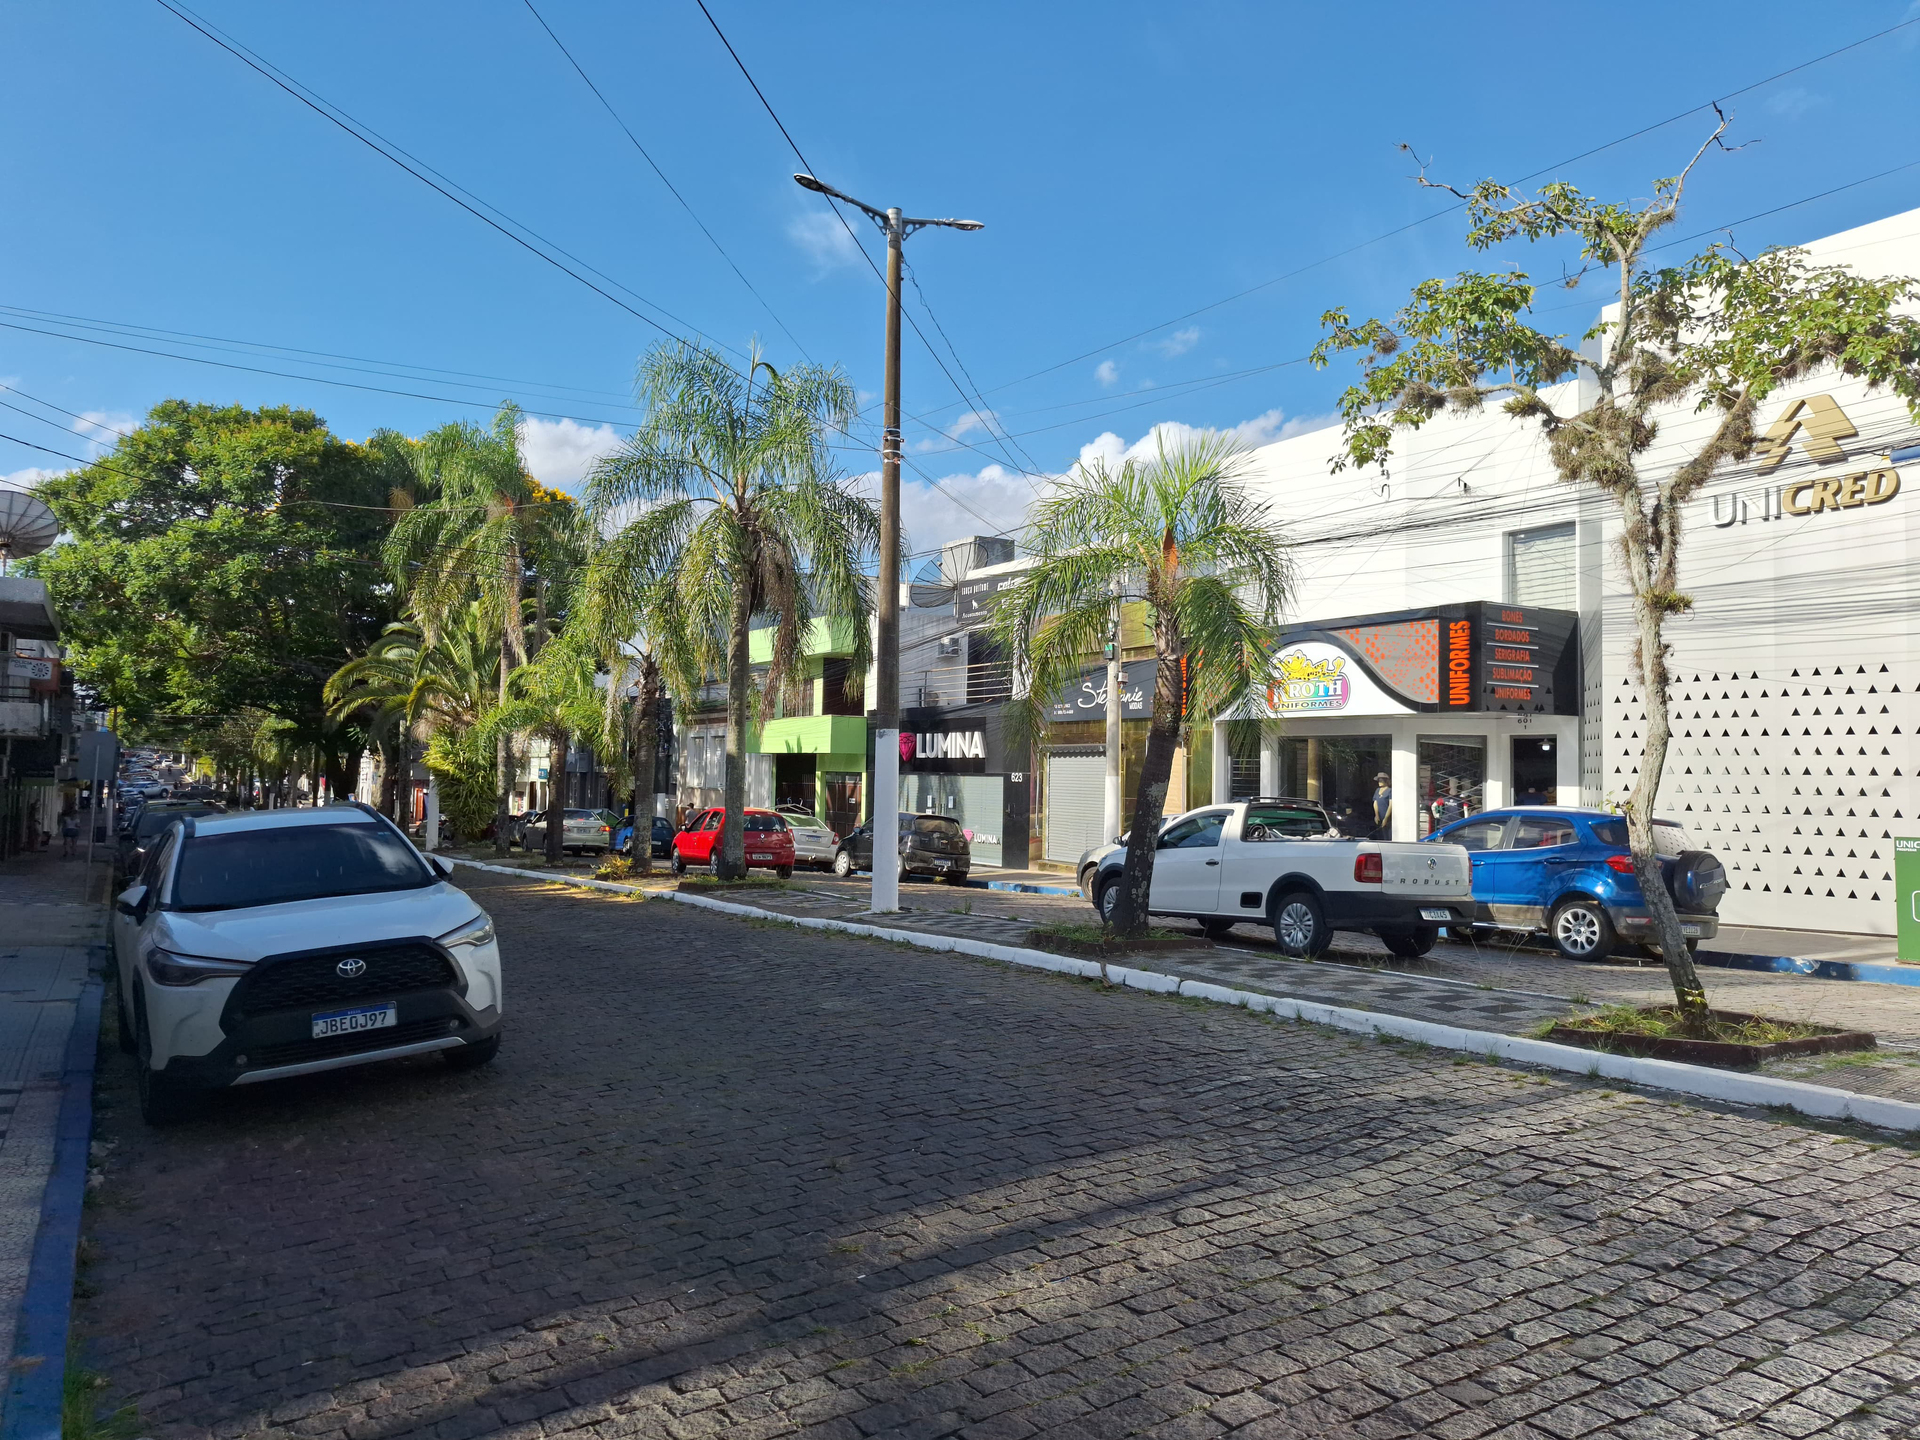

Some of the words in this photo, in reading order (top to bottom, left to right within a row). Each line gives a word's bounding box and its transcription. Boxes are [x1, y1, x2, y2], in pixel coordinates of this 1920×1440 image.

[1709, 468, 1901, 528] UNICRED
[1495, 629, 1530, 642] BORDADOS
[1495, 648, 1530, 662] SERIGRAFIA
[1449, 621, 1470, 705] UNIFORMES
[1492, 667, 1533, 684] SUBLIMAÇÃO
[1495, 687, 1531, 700] UNIFORMES
[1129, 702, 1143, 710] MODAS
[1273, 701, 1342, 710] UNIFORMES
[915, 731, 986, 759] LUMINA
[1011, 773, 1023, 782] 623
[974, 833, 998, 844] LUMINA
[1400, 878, 1460, 886] ROBUST
